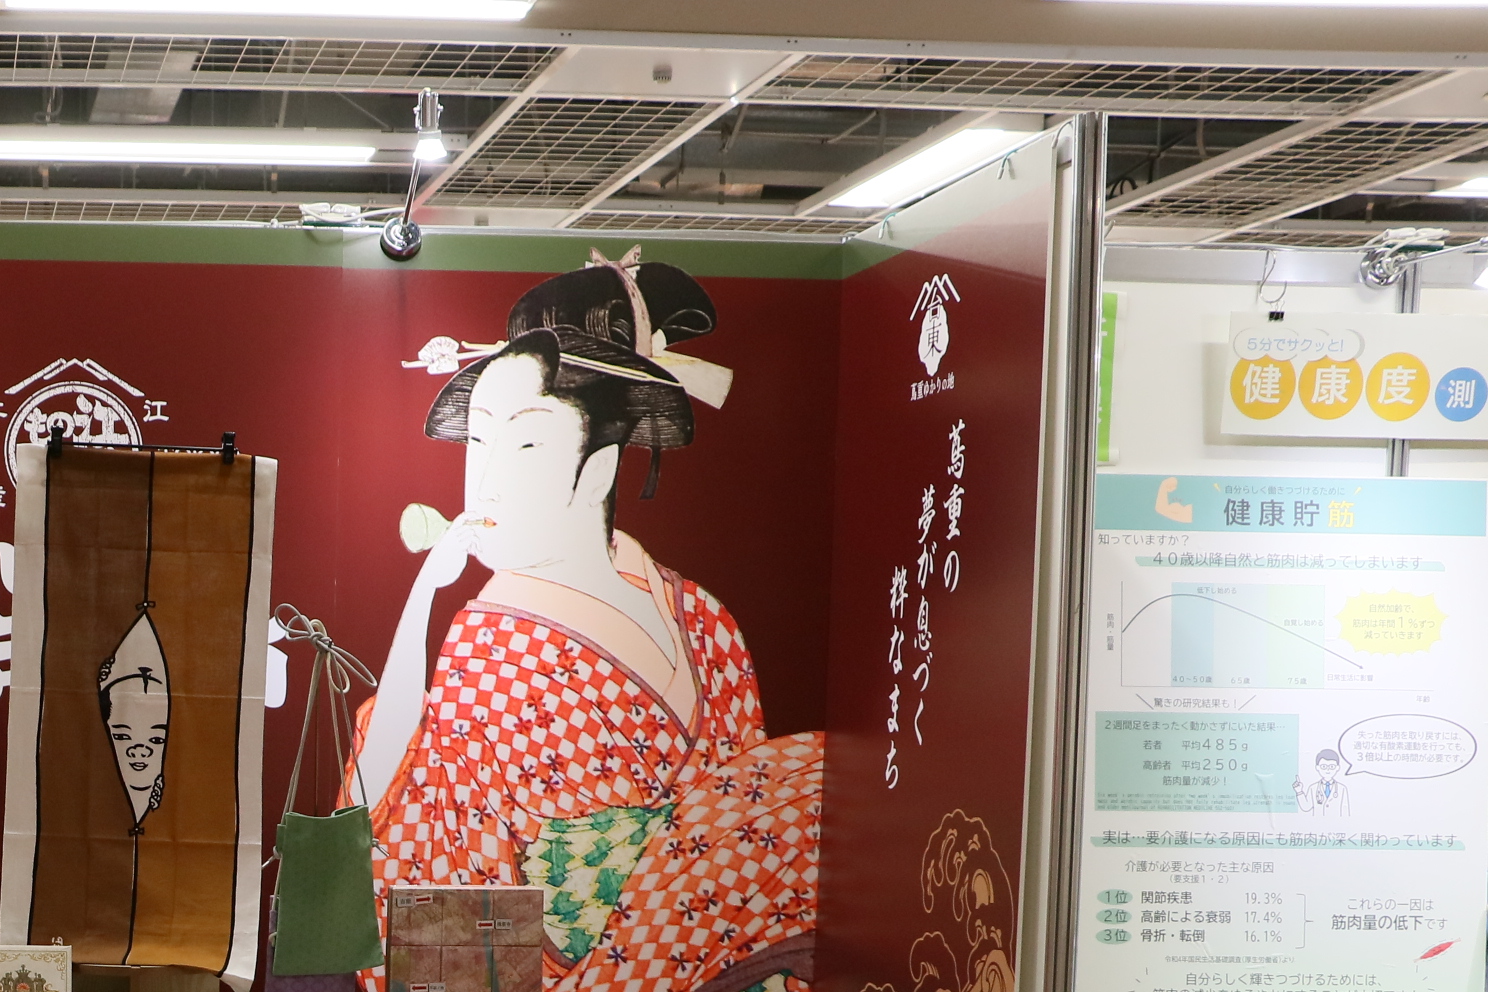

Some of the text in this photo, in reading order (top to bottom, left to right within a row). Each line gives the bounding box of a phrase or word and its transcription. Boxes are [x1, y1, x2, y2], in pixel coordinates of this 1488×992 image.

[143, 400, 170, 422] 江
[942, 418, 966, 593] 蔦重の
[1223, 499, 1355, 528] 健康貯筋
[912, 484, 937, 746] 夢が息づく
[1143, 740, 1162, 751] 若者
[1143, 759, 1172, 771] 高齢者
[1124, 860, 1275, 874] 介護が必要となった主な原因
[1105, 891, 1283, 905] 1位 関節疾患 19.3%
[1104, 910, 1283, 924] 2位 高齢による衰弱 17.4%
[1331, 914, 1448, 932] 筋肉量の低下です
[1103, 929, 1129, 942] 3位
[1244, 930, 1283, 943] 16.1%
